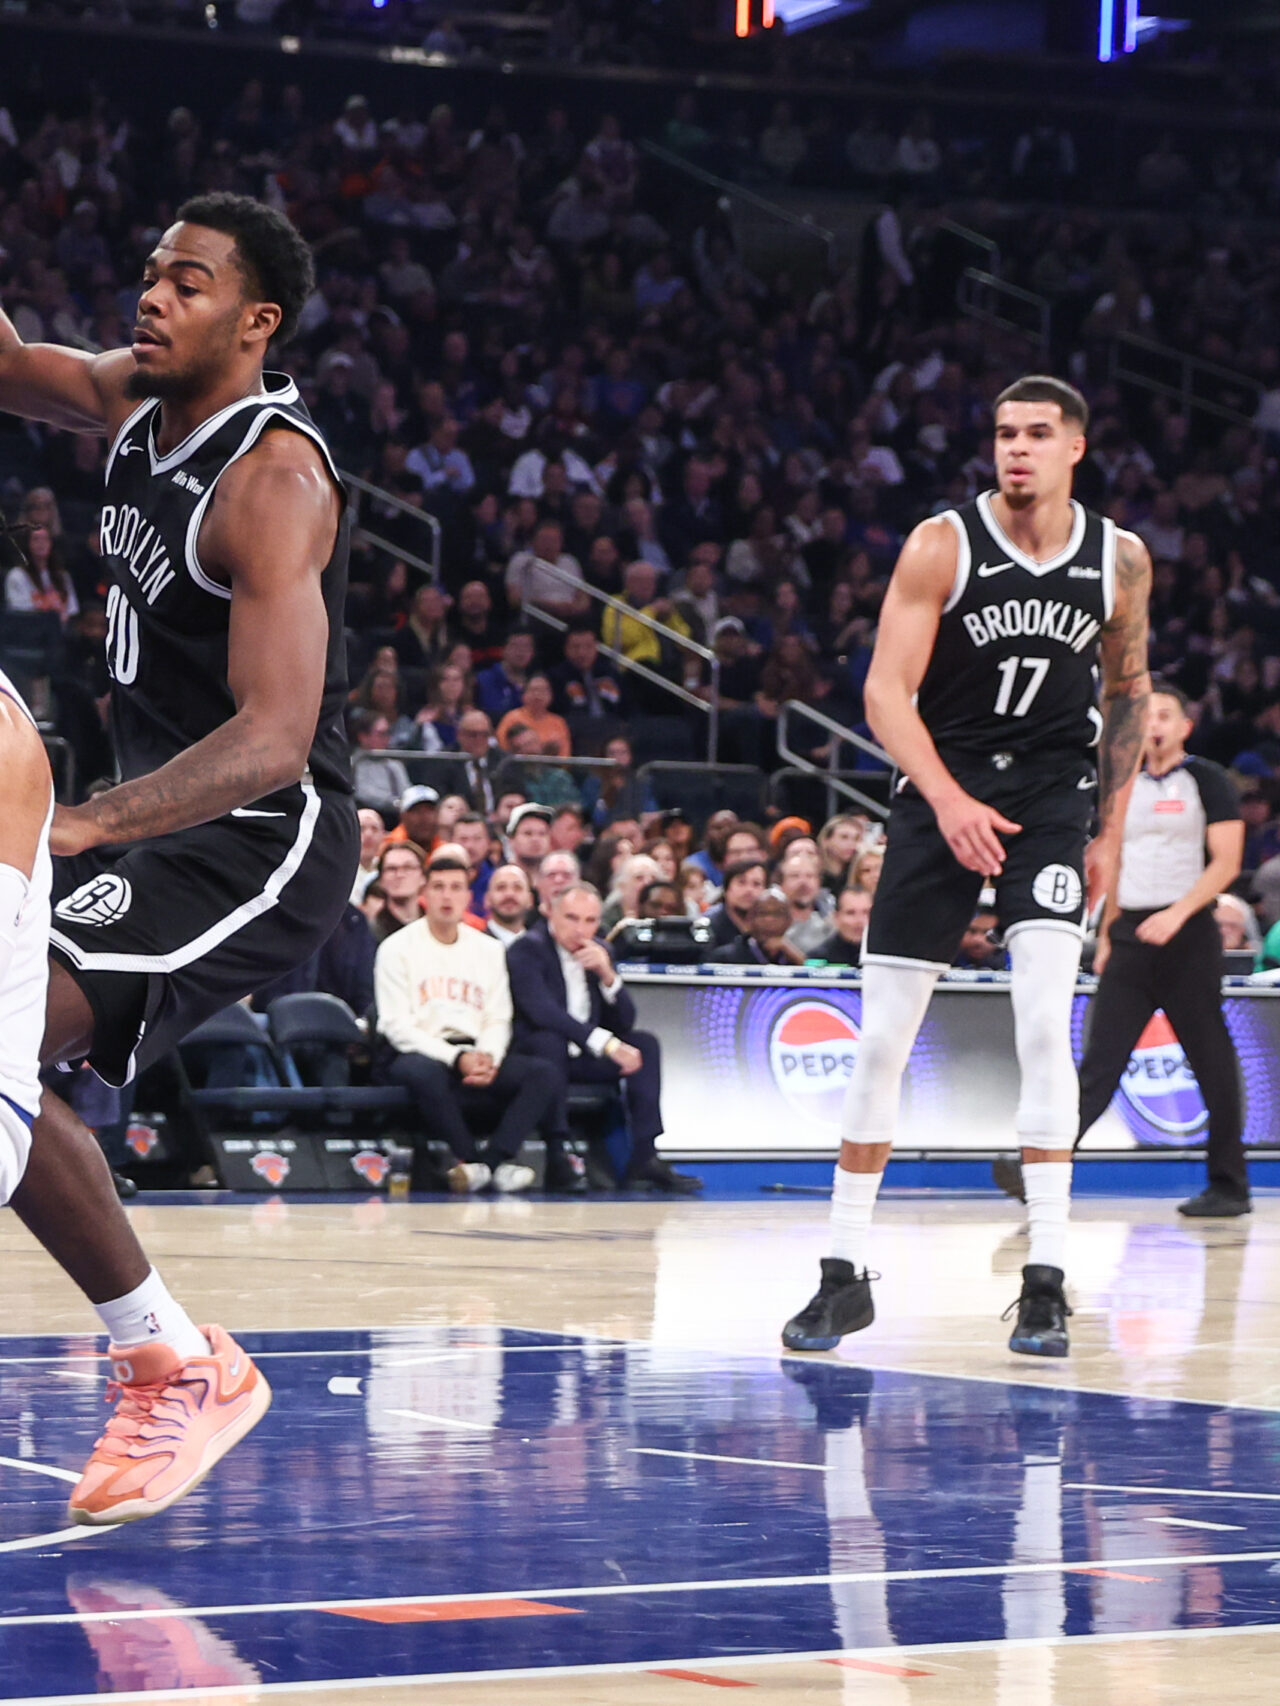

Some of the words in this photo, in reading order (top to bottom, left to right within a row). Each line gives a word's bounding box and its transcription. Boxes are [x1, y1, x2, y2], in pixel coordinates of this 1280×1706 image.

[100, 503, 176, 606] ROOLYN
[962, 599, 1102, 653] BROOKLYN
[993, 656, 1051, 717] 17
[781, 1053, 856, 1078] PEPS
[1126, 1058, 1196, 1080] PEPS
